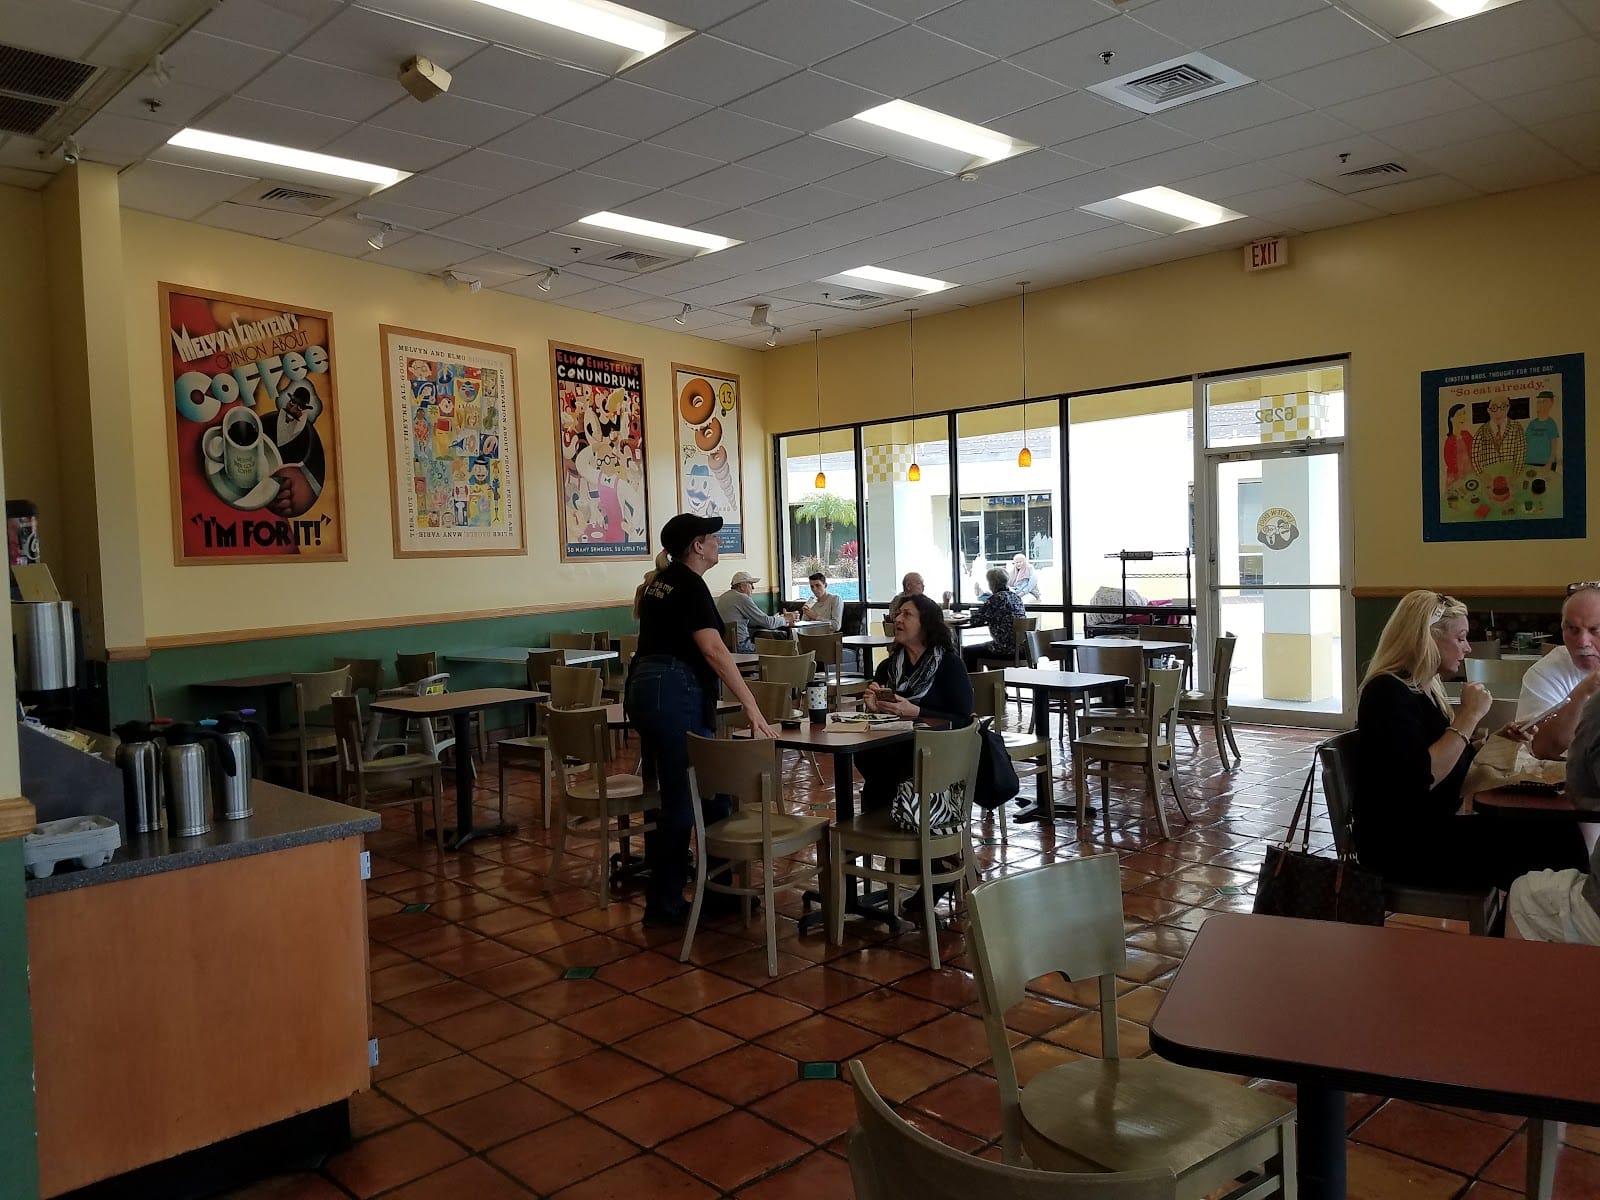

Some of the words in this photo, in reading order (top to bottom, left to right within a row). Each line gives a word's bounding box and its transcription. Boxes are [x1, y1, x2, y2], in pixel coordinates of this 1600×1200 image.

[1252, 240, 1278, 267] EXIT
[171, 322, 239, 363] MELVYN
[230, 312, 299, 348] EINSTEIN'S
[215, 344, 266, 370] OPINION
[272, 331, 309, 351] ABOUT
[398, 344, 428, 356] MELVYN
[431, 350, 445, 358] AND
[447, 352, 466, 361] ELMO
[557, 351, 584, 366] ELMO
[586, 357, 639, 376] EINSTEIN'S
[557, 364, 640, 390] CONUNDRUM:
[1444, 374, 1470, 383] EINSTEIN
[1488, 370, 1514, 379] THOUGHT
[722, 391, 732, 404] 13
[1473, 384, 1491, 395] eat
[243, 520, 292, 547] FOR
